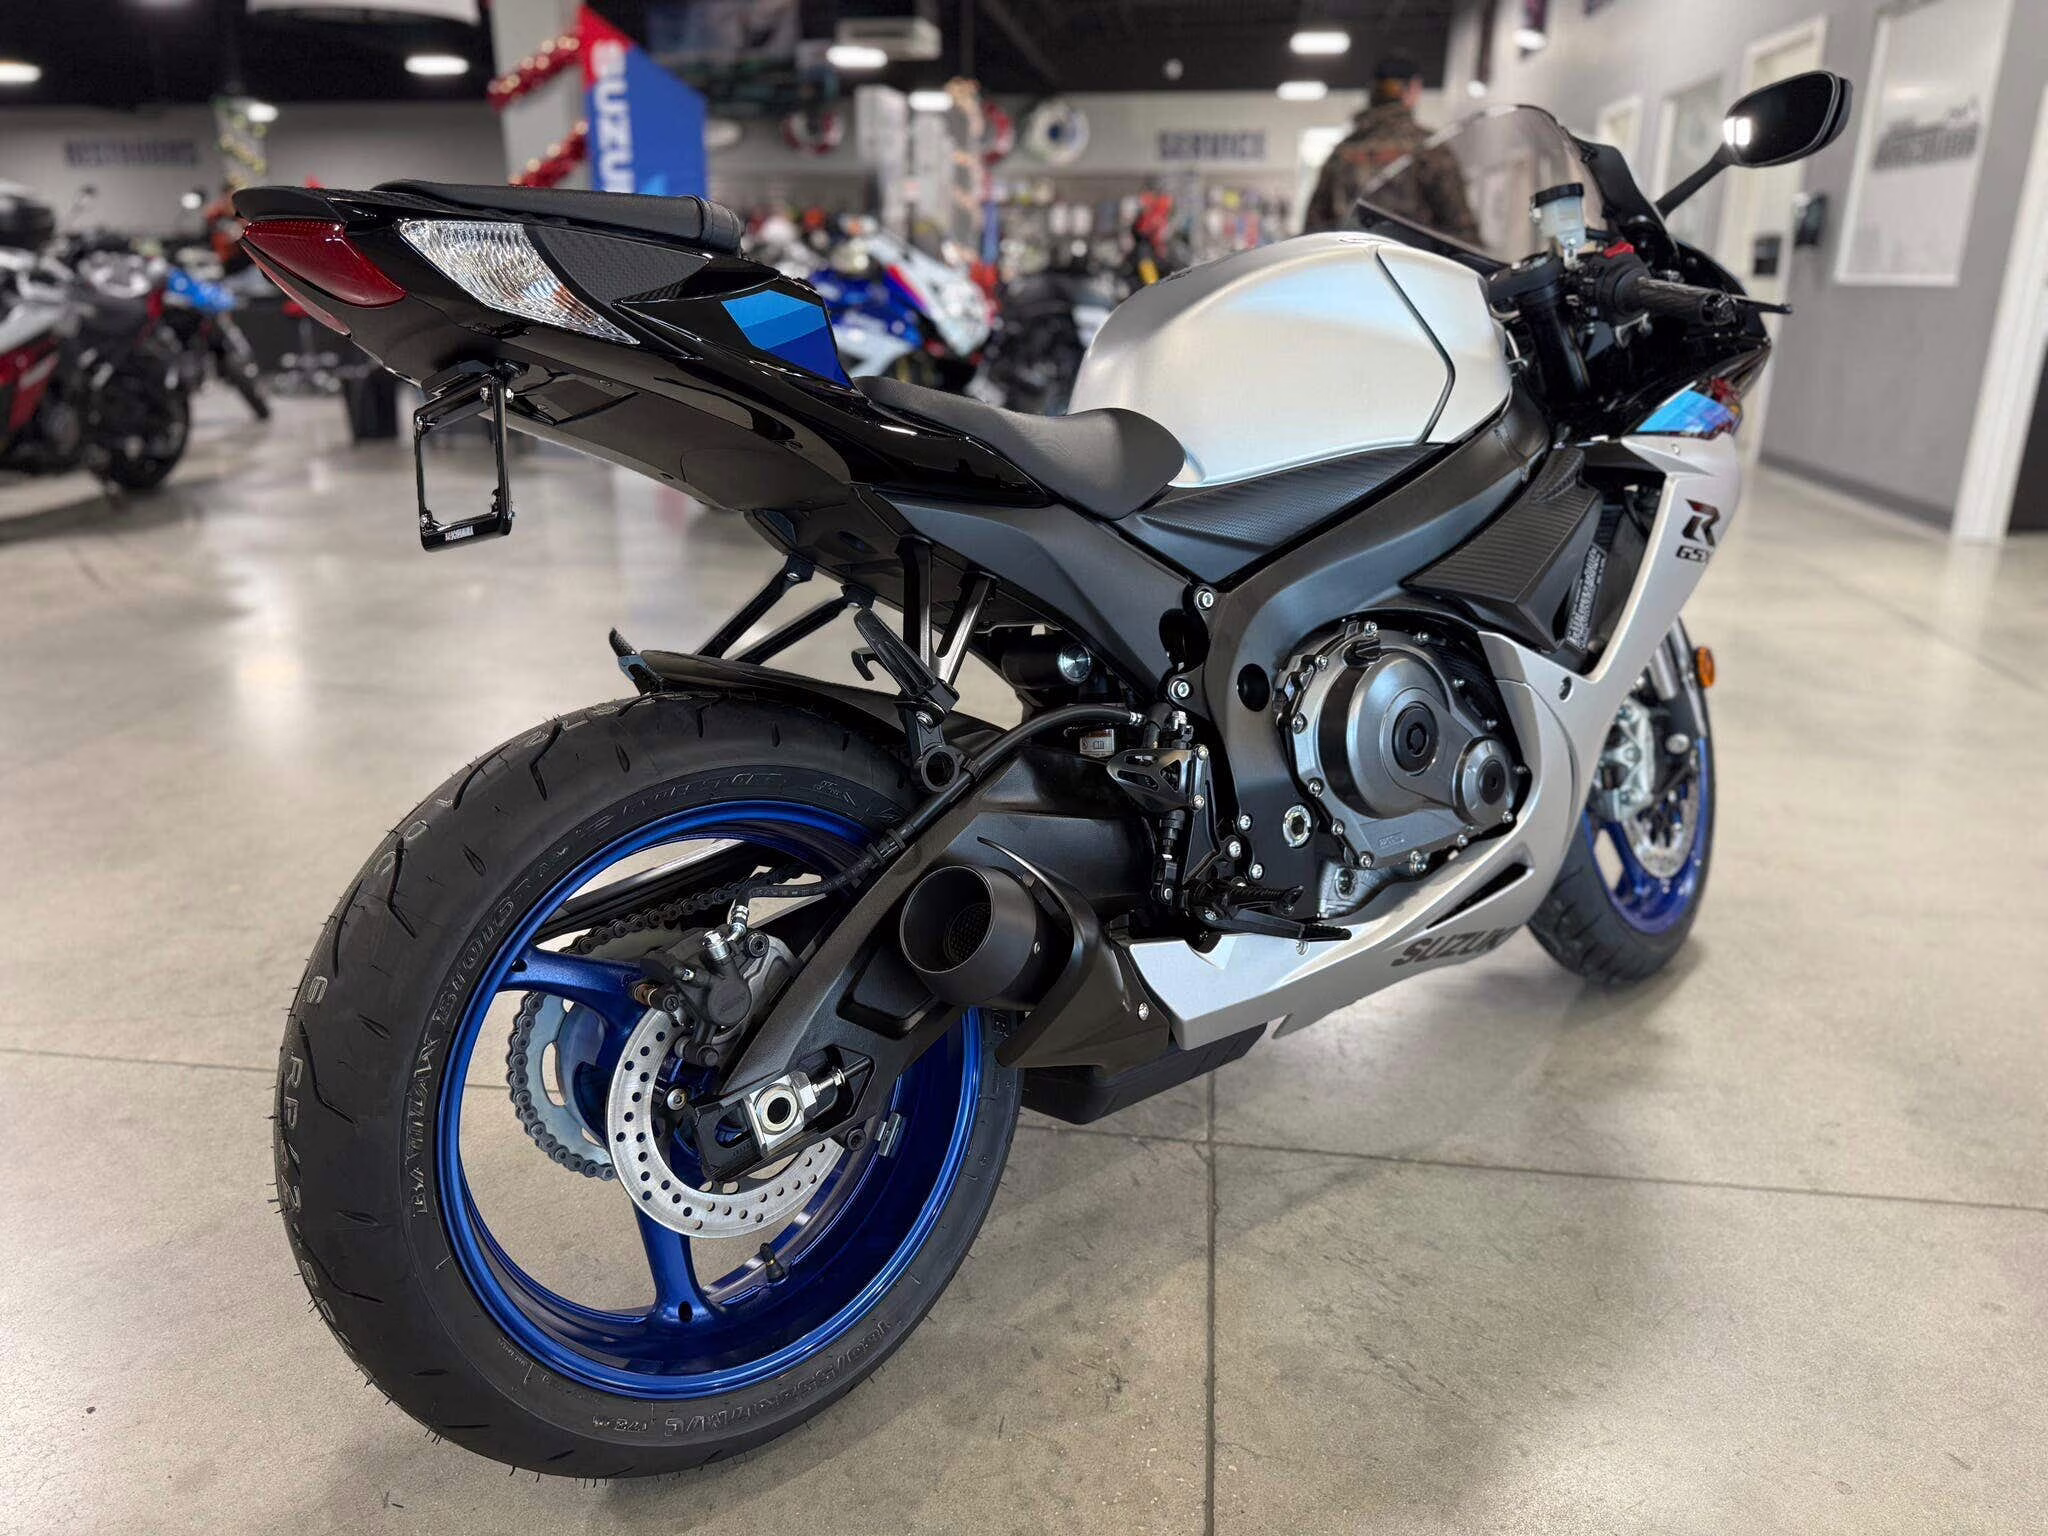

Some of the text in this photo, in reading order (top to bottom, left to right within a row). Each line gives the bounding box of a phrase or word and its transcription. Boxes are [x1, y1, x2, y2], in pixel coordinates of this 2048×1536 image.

[592, 37, 636, 193] SUZU
[1157, 131, 1265, 159] SERVICE
[1682, 498, 1720, 547] R
